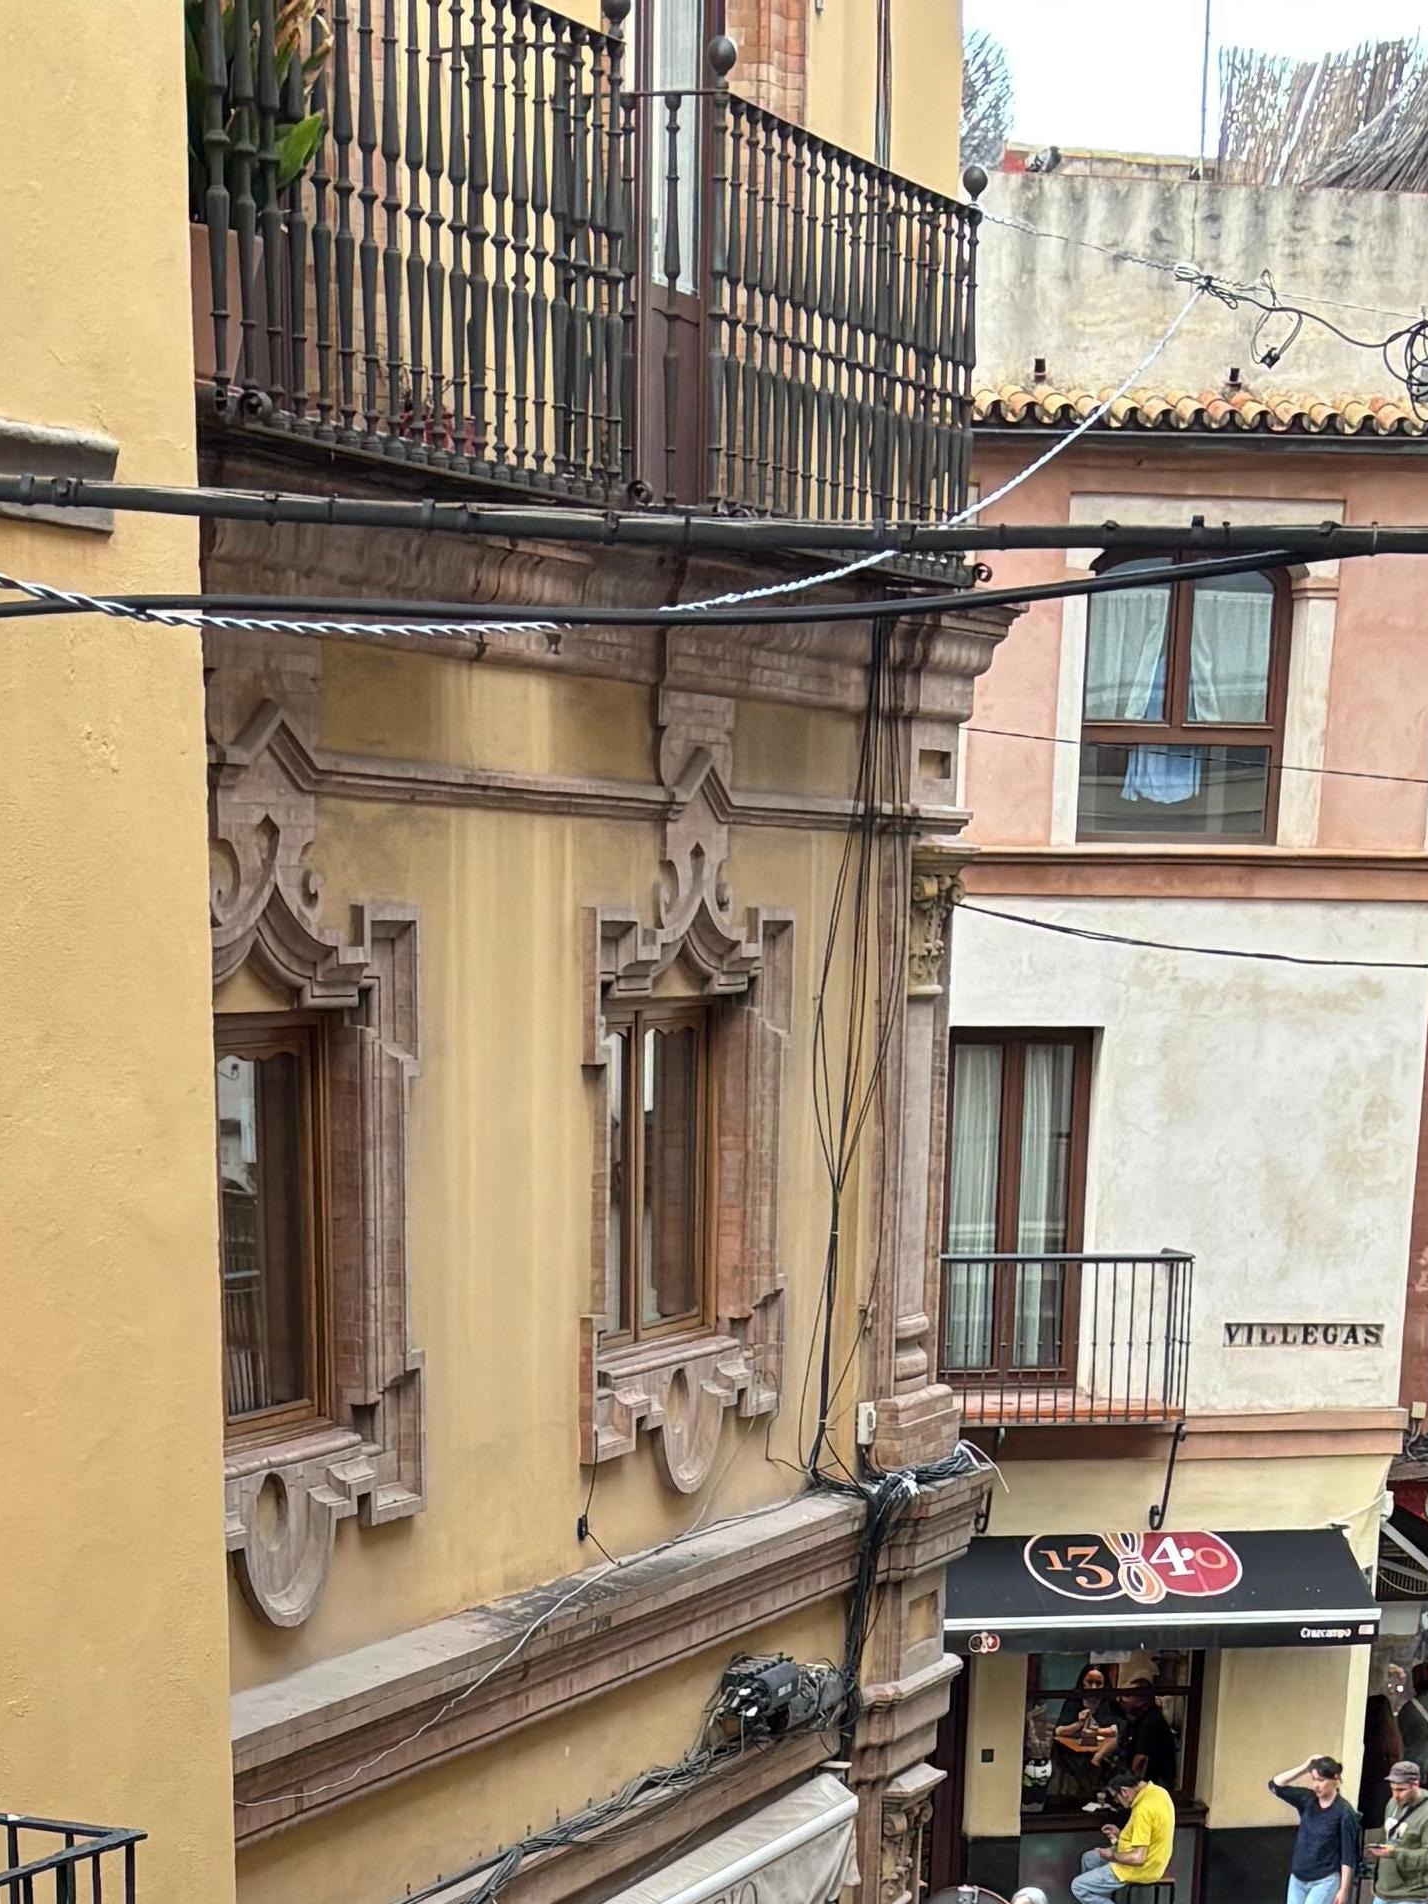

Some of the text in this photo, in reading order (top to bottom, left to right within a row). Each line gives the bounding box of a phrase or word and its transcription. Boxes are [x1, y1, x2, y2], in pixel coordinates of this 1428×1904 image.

[1226, 1323, 1381, 1346] VILLEGAS
[1039, 1536, 1228, 1589] 13 40
